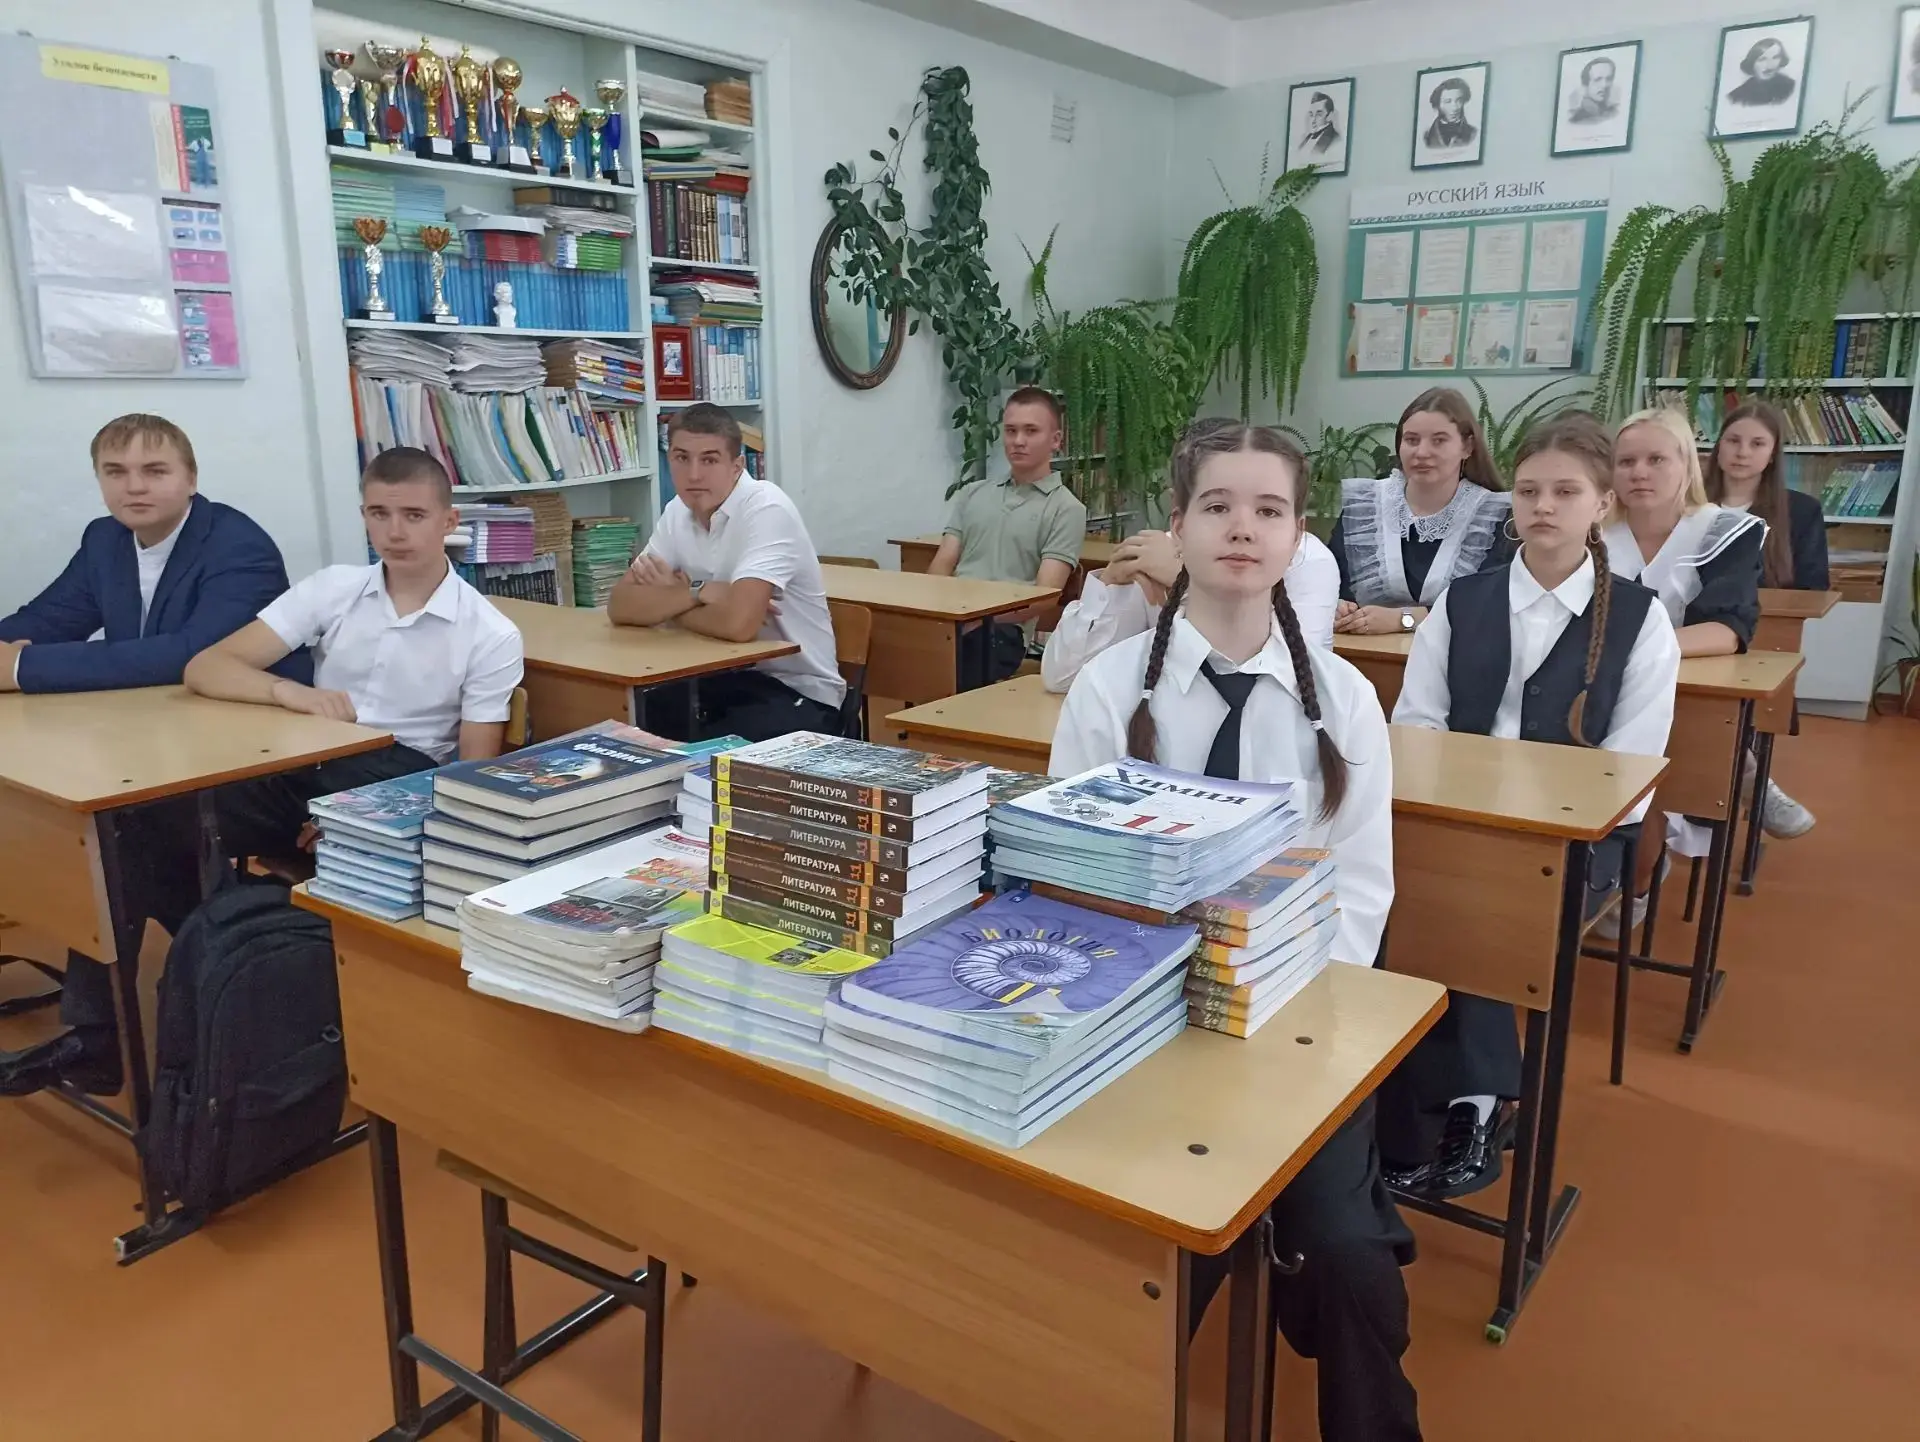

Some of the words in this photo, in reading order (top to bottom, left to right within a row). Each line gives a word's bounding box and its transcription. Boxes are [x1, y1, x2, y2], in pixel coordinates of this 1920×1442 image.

[1407, 181, 1489, 206] РУССКИЙ
[1494, 180, 1545, 199] ЯЗЫК
[789, 779, 848, 799] ЛИТЕРАТУРА
[857, 788, 870, 806] 11
[789, 804, 848, 825] ЛИТЕРАТУРА
[856, 814, 869, 832] 11
[1111, 813, 1196, 836] 11
[789, 829, 847, 851] ЛИТЕРАТУРА
[855, 839, 868, 857] 11
[783, 852, 841, 874] ЛИТЕРАТУРА
[848, 863, 862, 881] 11
[780, 875, 837, 897] ЛИТЕРАТУРА
[845, 886, 859, 904] 11
[782, 897, 837, 921] ЛИТЕРАТУРА
[844, 911, 857, 928] 11
[777, 919, 833, 942] ЛИТЕРАТУРА
